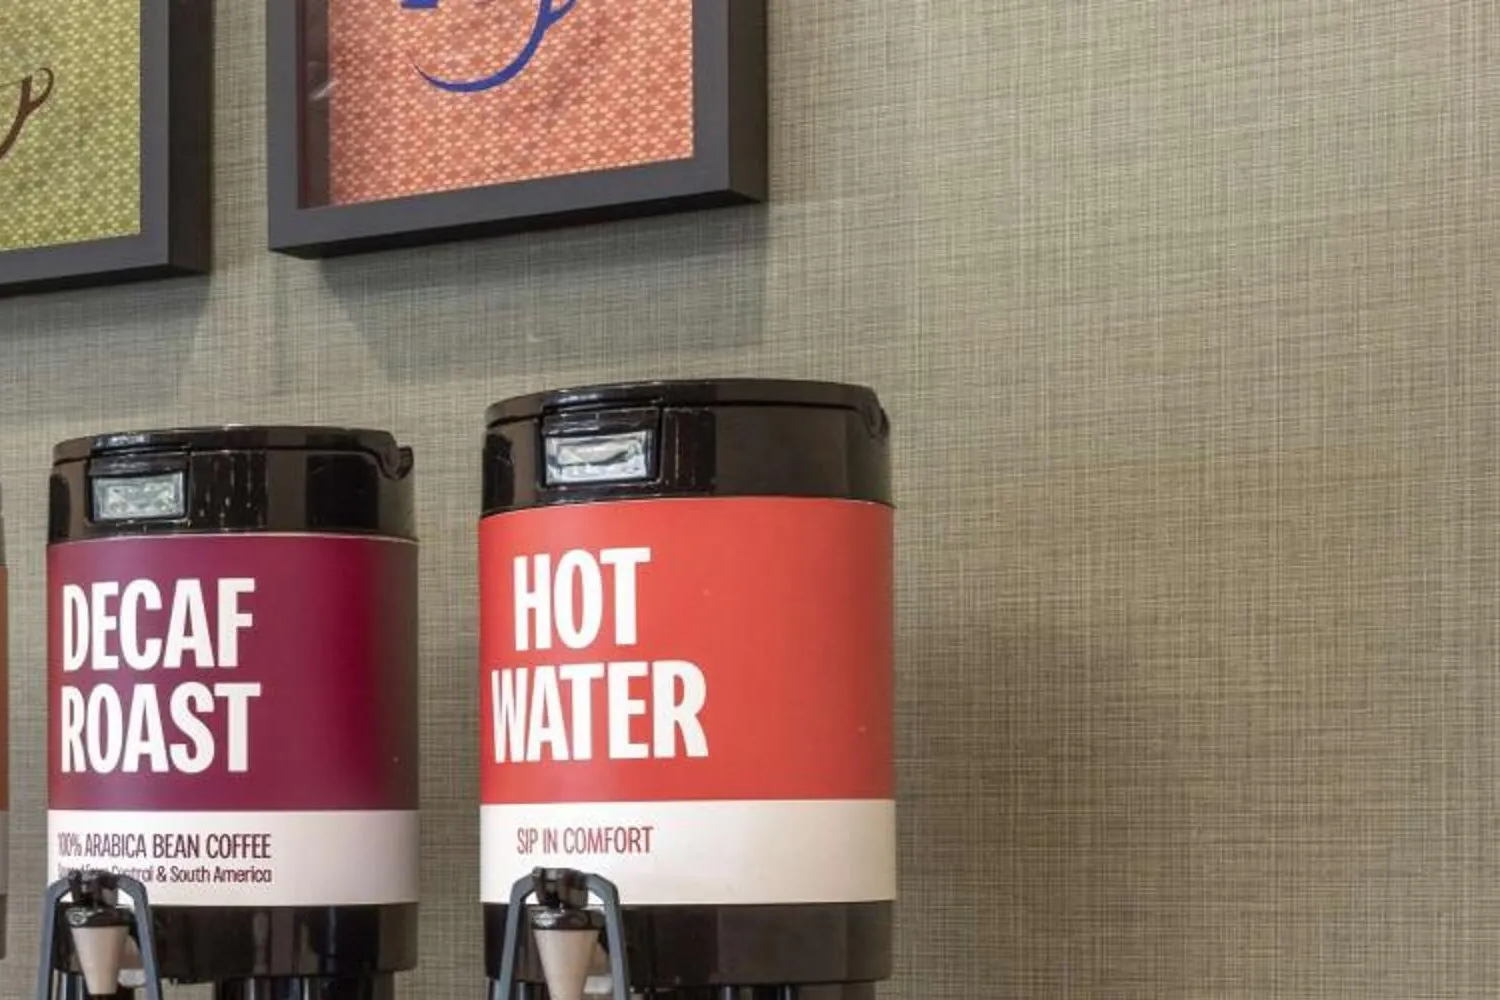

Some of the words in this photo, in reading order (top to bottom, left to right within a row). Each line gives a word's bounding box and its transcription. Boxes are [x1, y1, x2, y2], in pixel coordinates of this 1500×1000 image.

[63, 578, 255, 671] DECAF
[514, 547, 651, 651] HOT
[61, 682, 261, 773] ROAST
[491, 659, 708, 764] WATER
[85, 833, 147, 858] ARABICA
[153, 833, 199, 858] BEAN
[206, 833, 272, 859] COFFEE
[157, 866, 167, 882] &
[170, 866, 210, 883] South
[214, 866, 272, 883] America
[516, 827, 538, 855] SIP
[543, 827, 558, 854] IN
[563, 826, 654, 854] COMFORT
